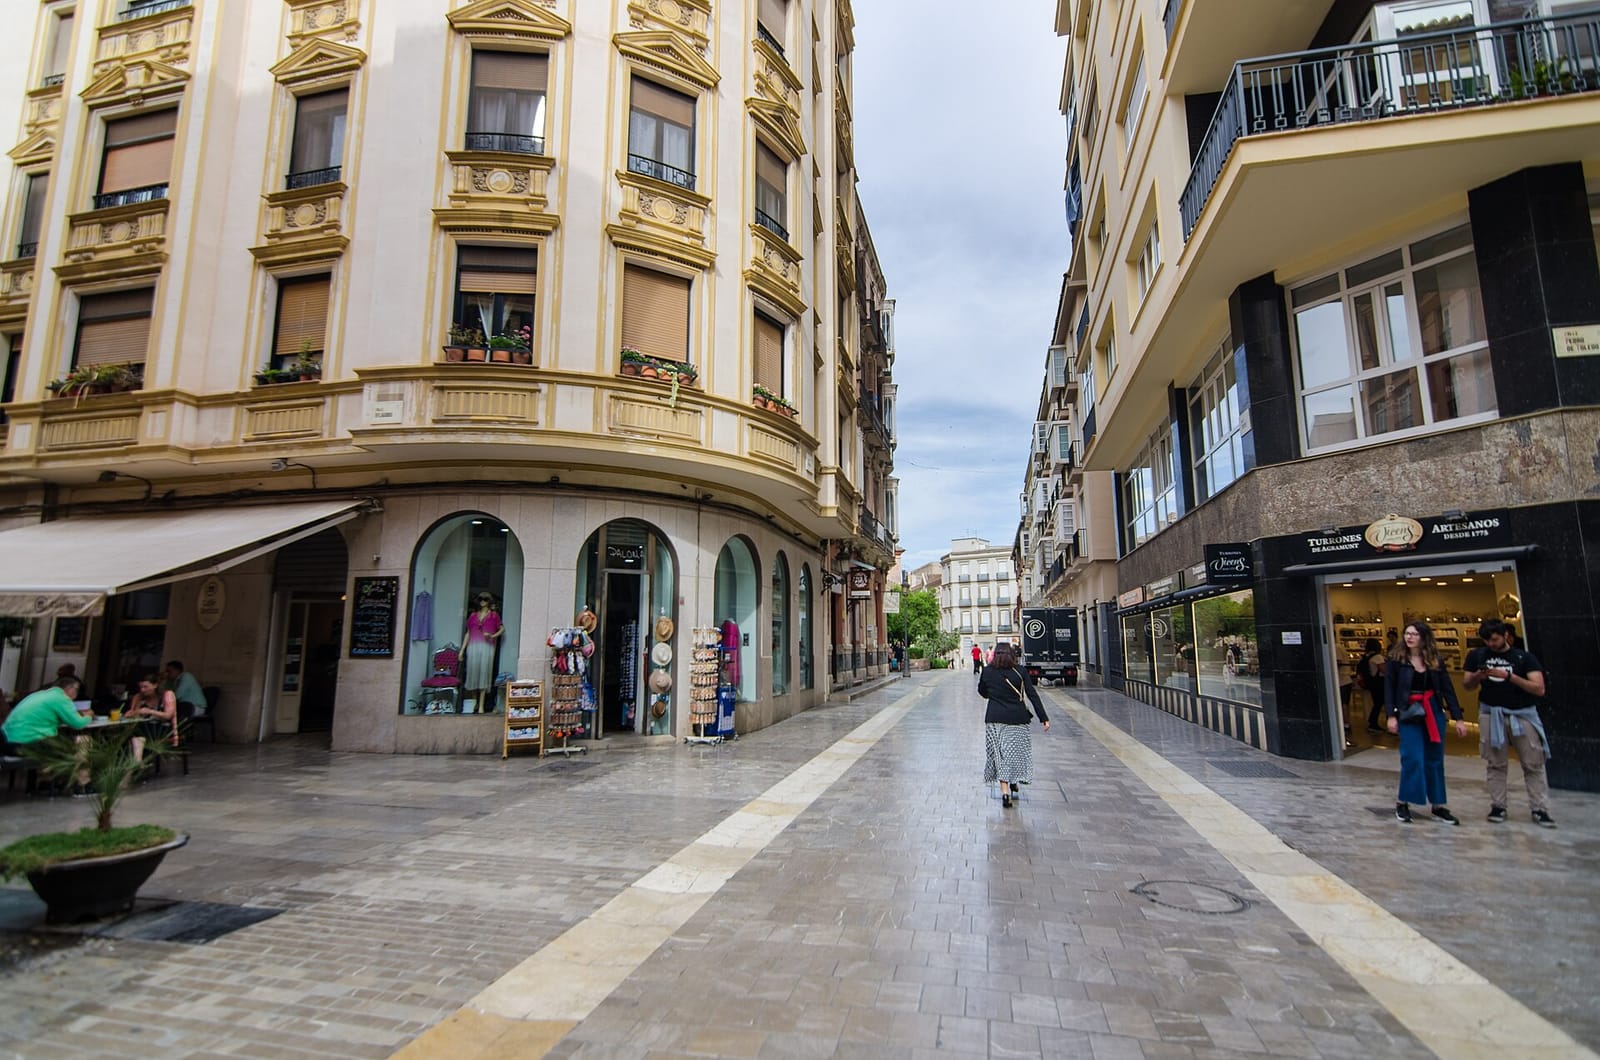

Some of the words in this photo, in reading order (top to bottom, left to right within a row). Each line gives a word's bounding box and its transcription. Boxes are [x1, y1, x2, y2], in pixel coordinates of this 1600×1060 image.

[1431, 518, 1500, 534] ARTESANOS
[1307, 533, 1362, 547] TURRONES
[1375, 524, 1419, 543] Vicens
[1443, 531, 1470, 540] DESDE
[1322, 543, 1360, 552] AGRAMUNT
[1210, 557, 1250, 571] Vicens
